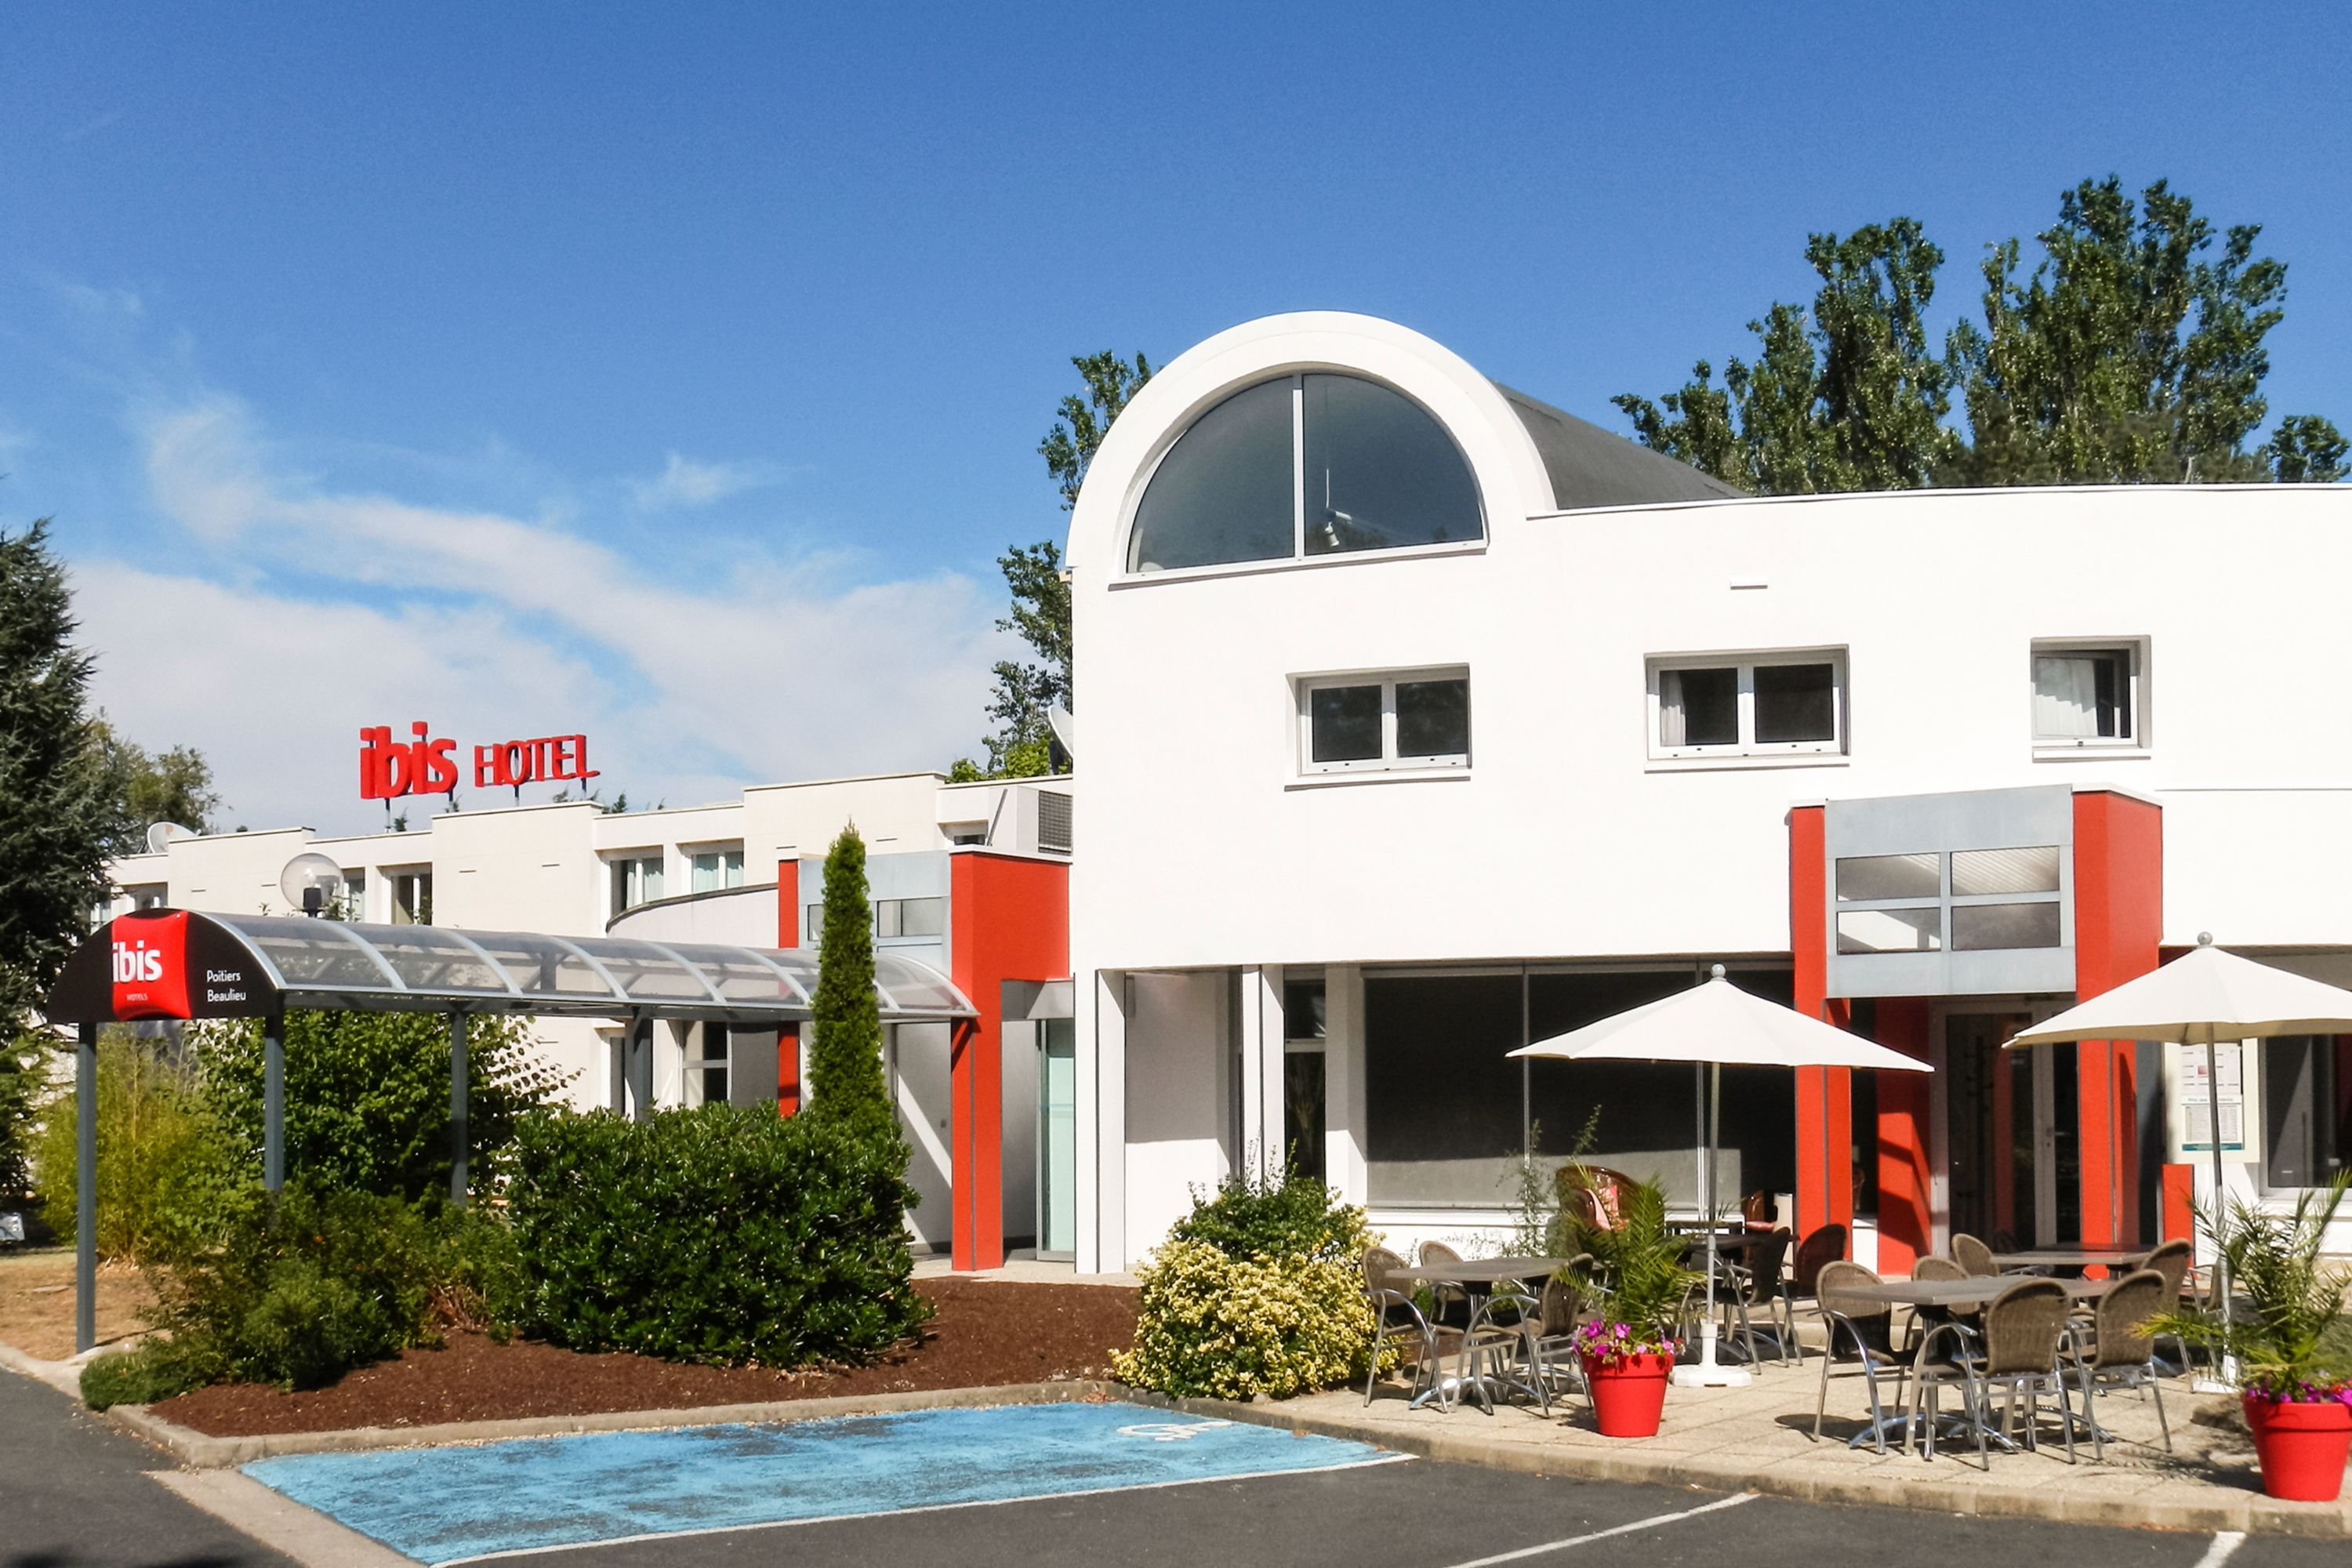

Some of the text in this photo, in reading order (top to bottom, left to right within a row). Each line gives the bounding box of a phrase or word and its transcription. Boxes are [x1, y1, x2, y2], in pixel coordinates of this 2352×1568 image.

[360, 721, 601, 799] ibis HOTEL
[112, 940, 162, 982] ibis
[207, 970, 241, 982] Poitiers
[126, 993, 148, 1001] HOTELS
[207, 988, 246, 1002] Beaulieu
